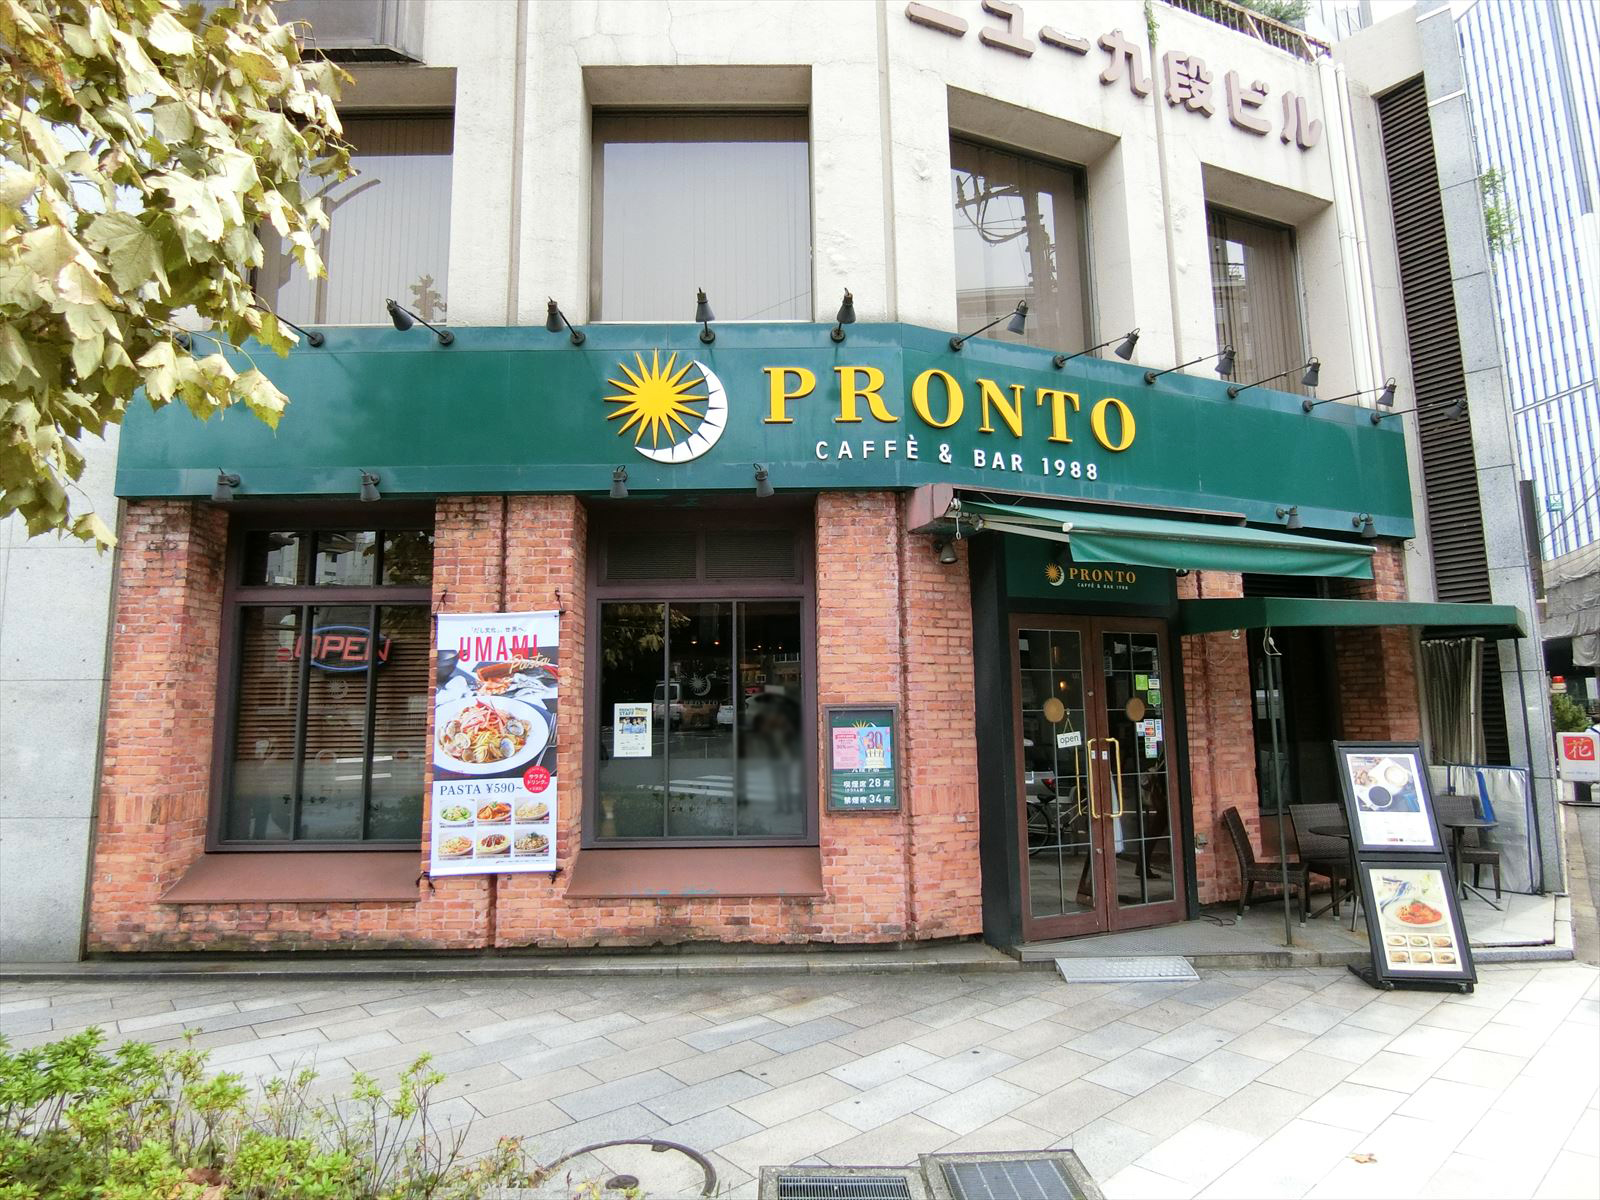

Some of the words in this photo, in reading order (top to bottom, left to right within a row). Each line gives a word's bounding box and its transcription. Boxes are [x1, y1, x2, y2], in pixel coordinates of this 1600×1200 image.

[762, 366, 1137, 453] PRONTO
[815, 434, 919, 460] CAFFÈ
[938, 443, 953, 464] &
[973, 449, 1024, 472] BAR
[1041, 457, 1099, 481] 1988
[1069, 567, 1137, 584] PRONTO
[294, 634, 392, 662] OPEN
[459, 633, 538, 662] UMAMI
[508, 652, 551, 674] Pasta
[1060, 735, 1079, 745] open
[1566, 738, 1592, 759] 花
[440, 784, 482, 796] PASTA
[868, 778, 881, 788] 28
[869, 794, 882, 804] 34
